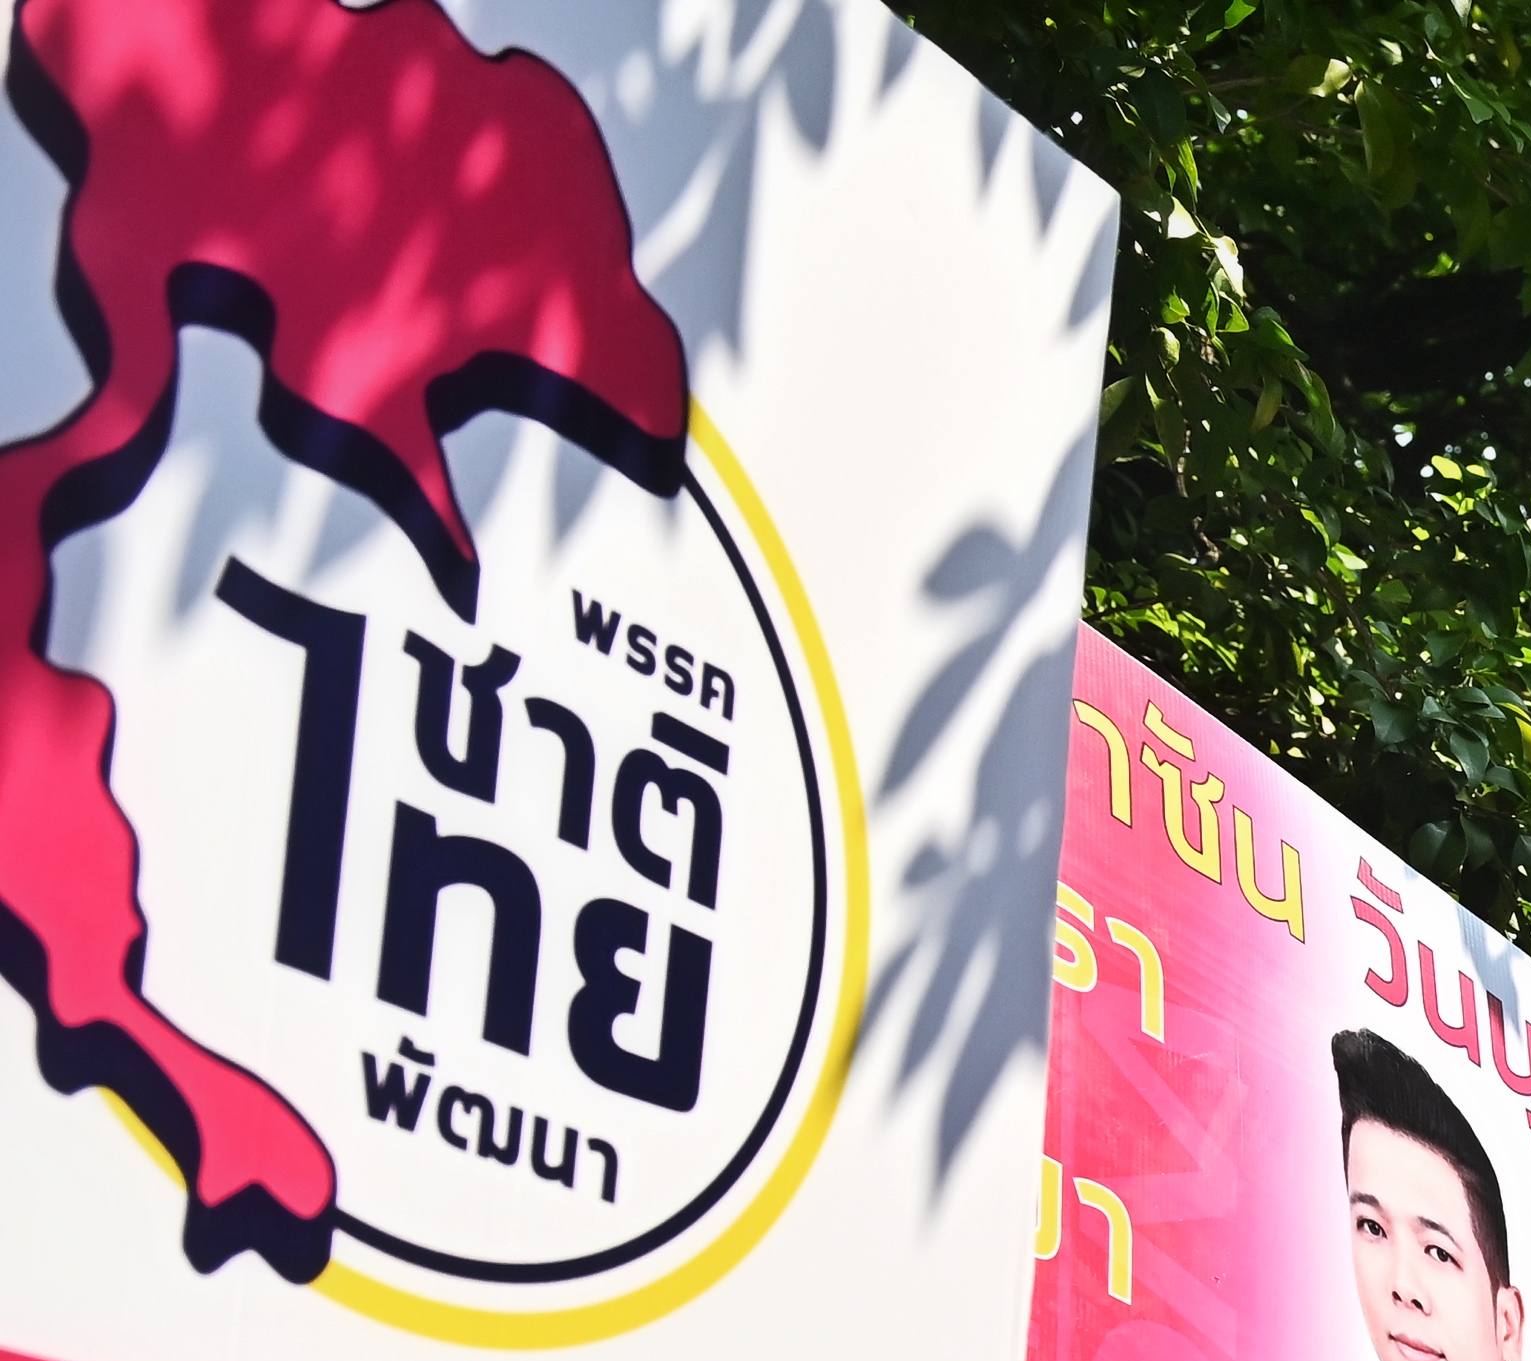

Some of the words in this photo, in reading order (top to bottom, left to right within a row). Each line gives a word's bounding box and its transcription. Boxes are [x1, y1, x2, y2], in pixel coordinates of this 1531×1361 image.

[568, 590, 737, 722] พรรค
[216, 555, 714, 1114] ไทย
[405, 637, 735, 912] ชาติ
[362, 1038, 623, 1207] พัฒนา
